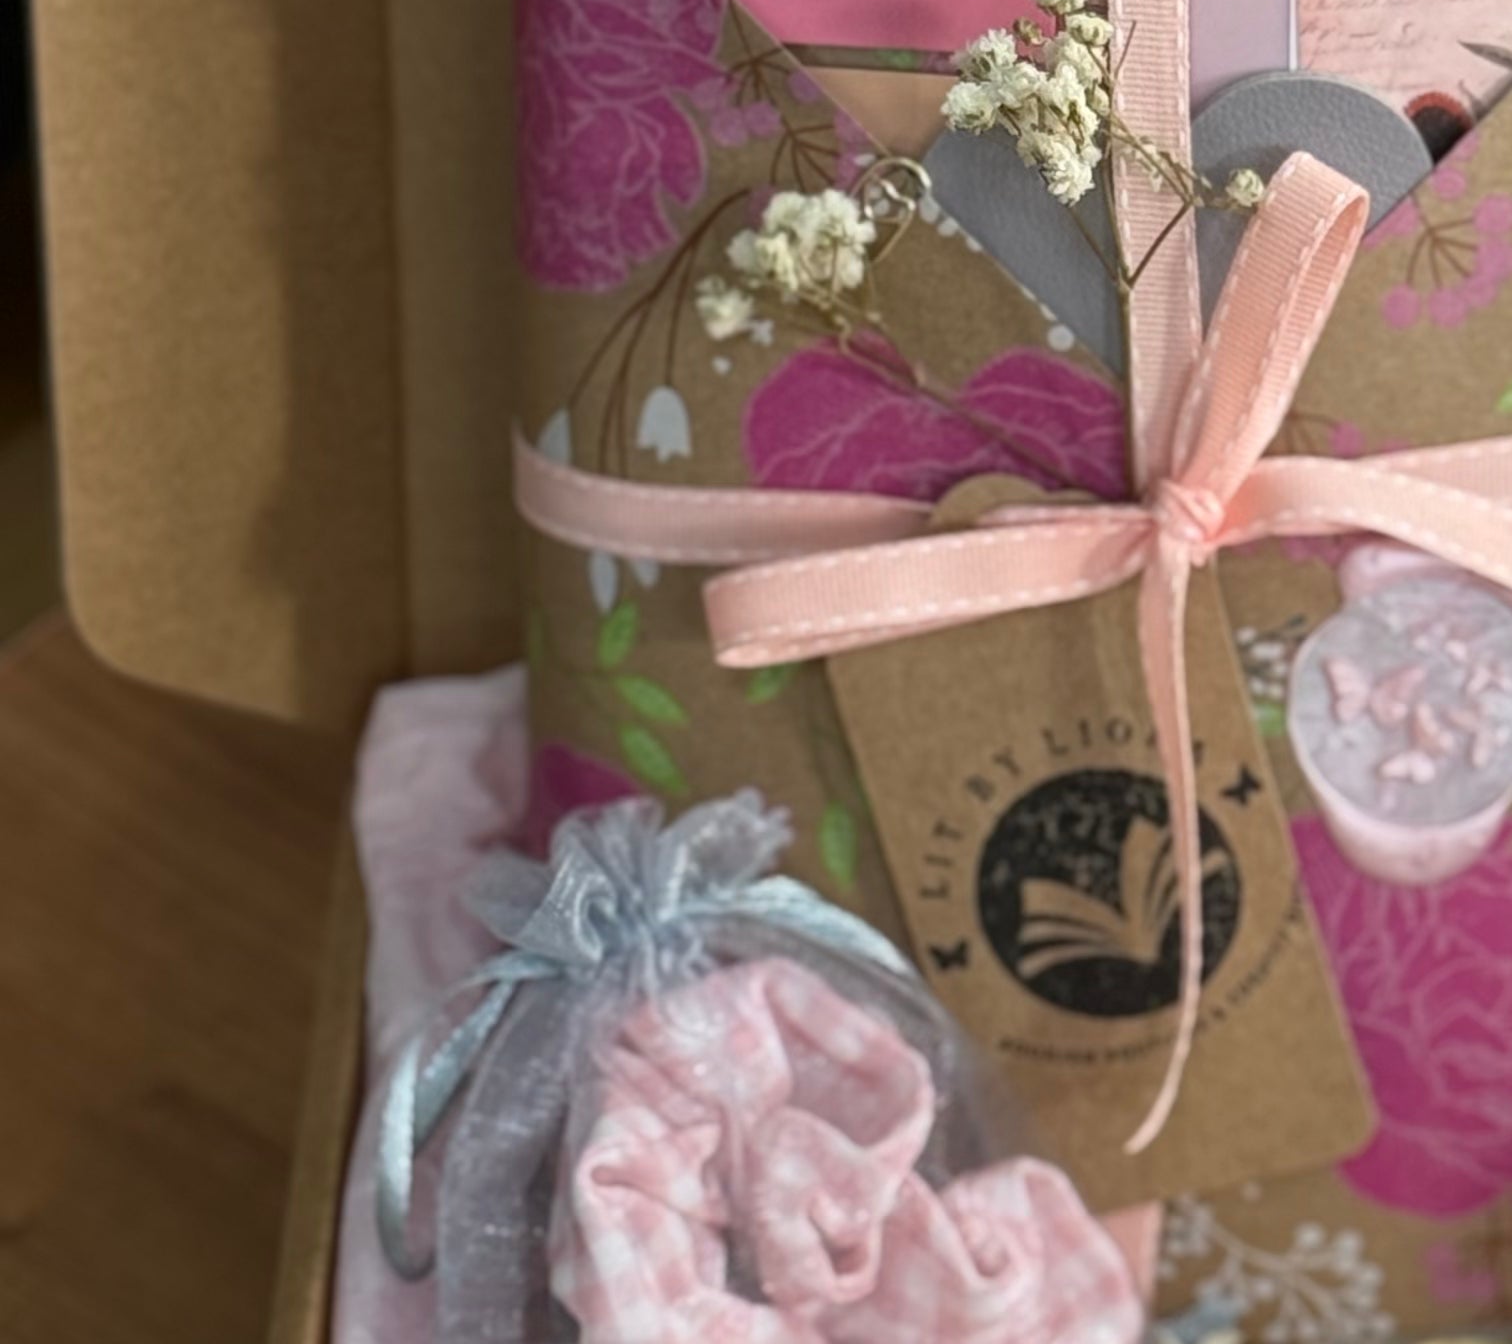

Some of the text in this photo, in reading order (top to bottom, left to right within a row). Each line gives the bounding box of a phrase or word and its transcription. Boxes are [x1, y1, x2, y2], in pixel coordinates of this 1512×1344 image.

[920, 717, 1205, 900] LIT BY LIO
